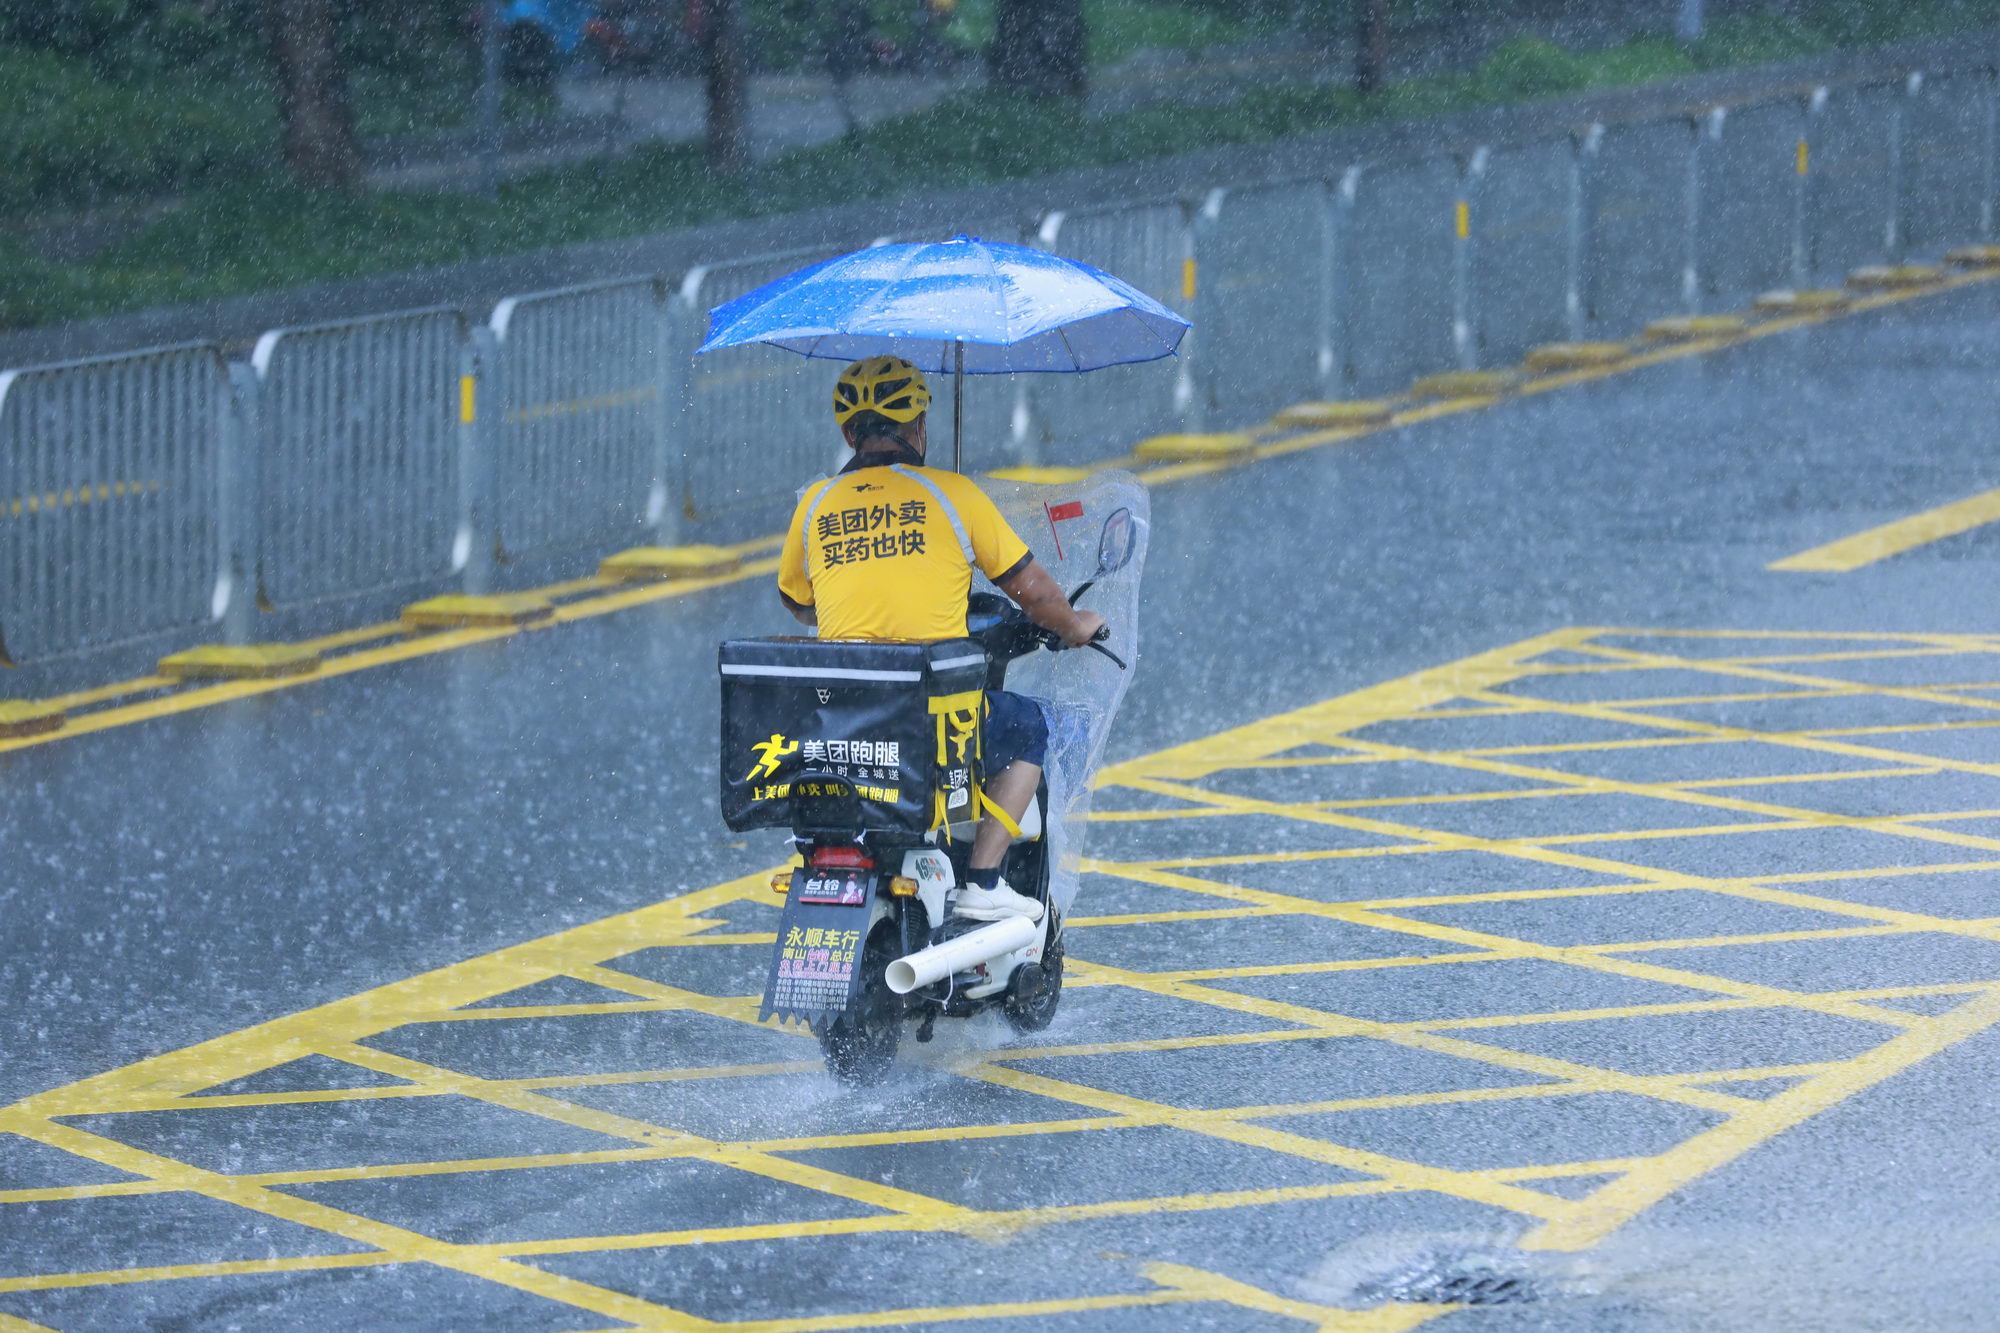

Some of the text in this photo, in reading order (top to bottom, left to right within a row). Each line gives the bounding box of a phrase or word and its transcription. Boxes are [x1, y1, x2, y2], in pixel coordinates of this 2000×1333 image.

[817, 500, 927, 542] 美团外卖
[822, 529, 926, 570] 买药也快
[803, 739, 900, 767] 美团跑腿
[805, 764, 900, 781] 一小时 全城送
[784, 926, 860, 950] 永顺车行
